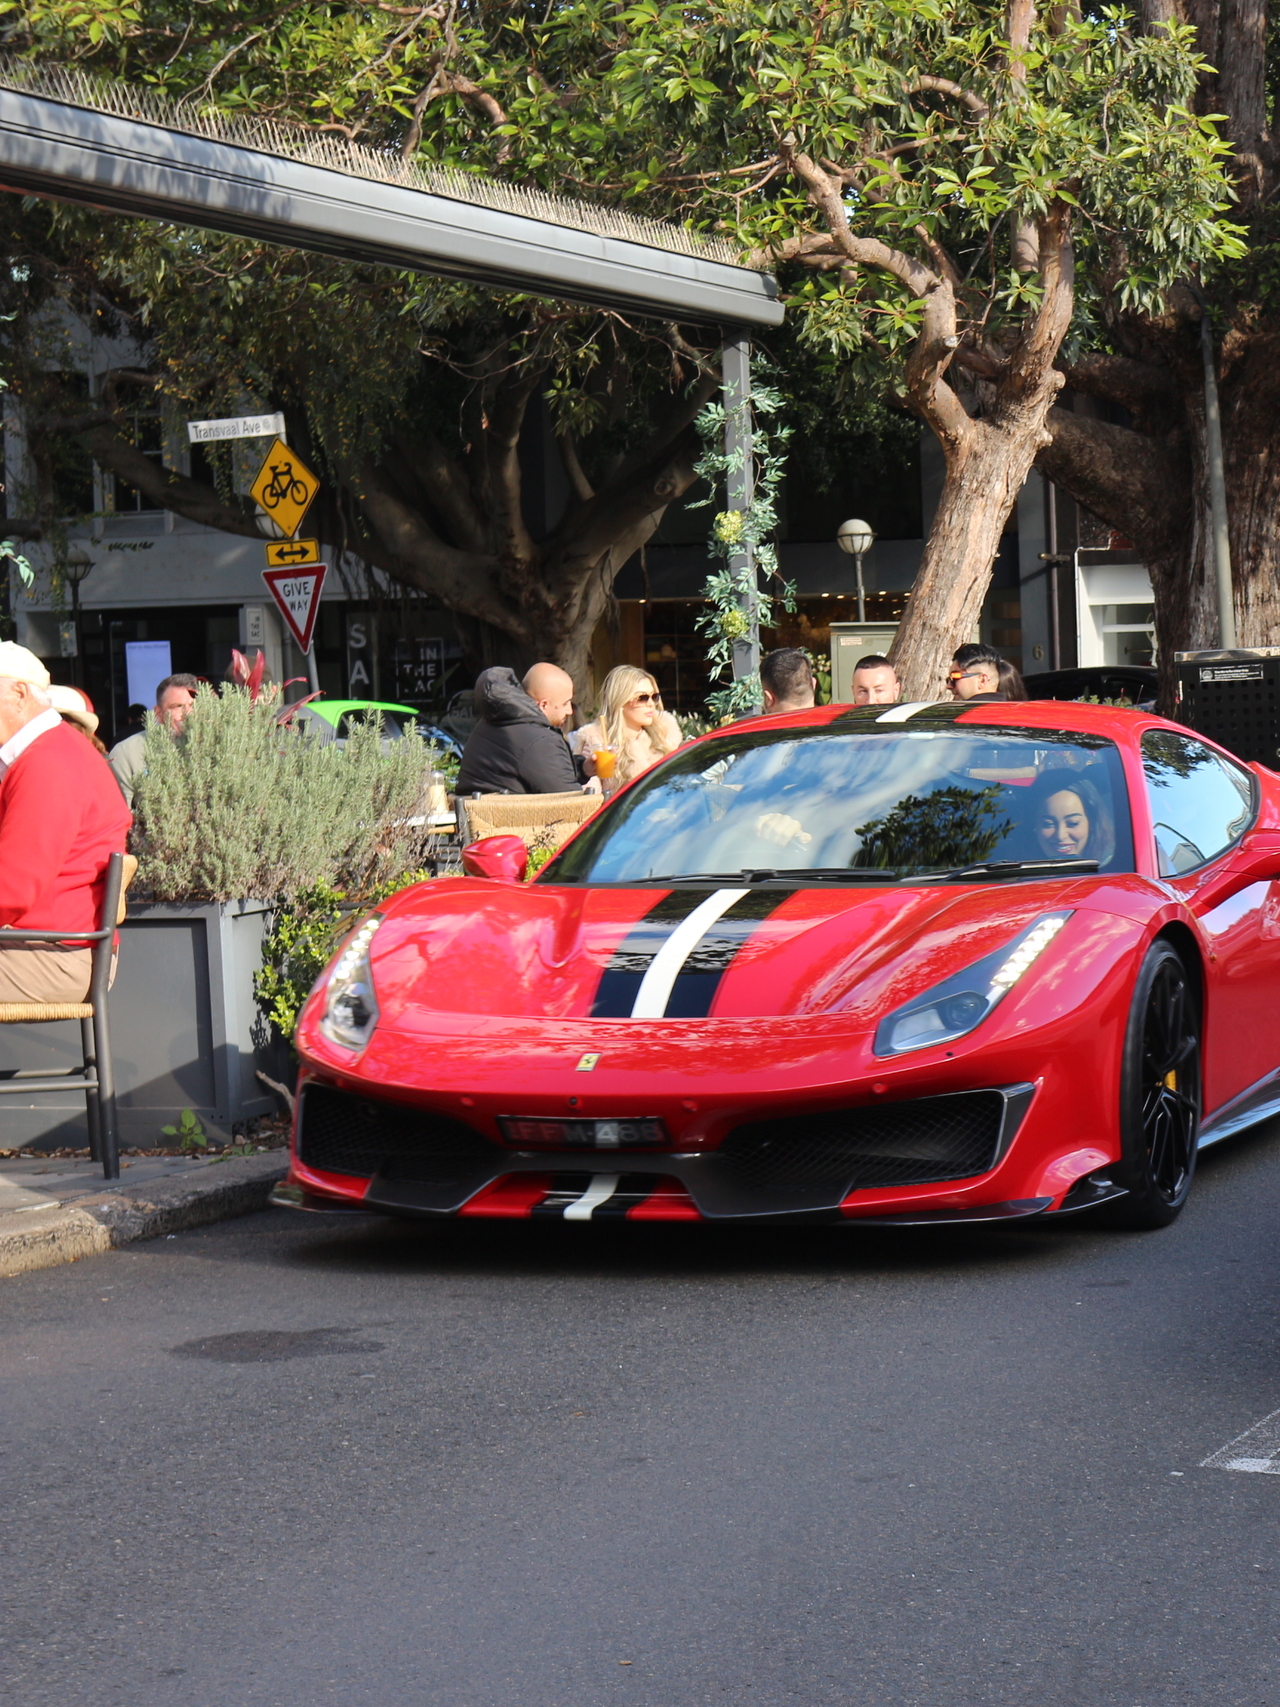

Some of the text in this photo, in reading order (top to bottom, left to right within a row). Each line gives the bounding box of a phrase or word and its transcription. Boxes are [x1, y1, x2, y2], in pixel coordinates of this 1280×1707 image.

[193, 420, 261, 439] Transvaal Ave
[283, 582, 311, 597] GIVE
[290, 600, 309, 612] WAY
[420, 647, 437, 660] IN
[1033, 644, 1044, 660] 6
[403, 663, 436, 677] THE
